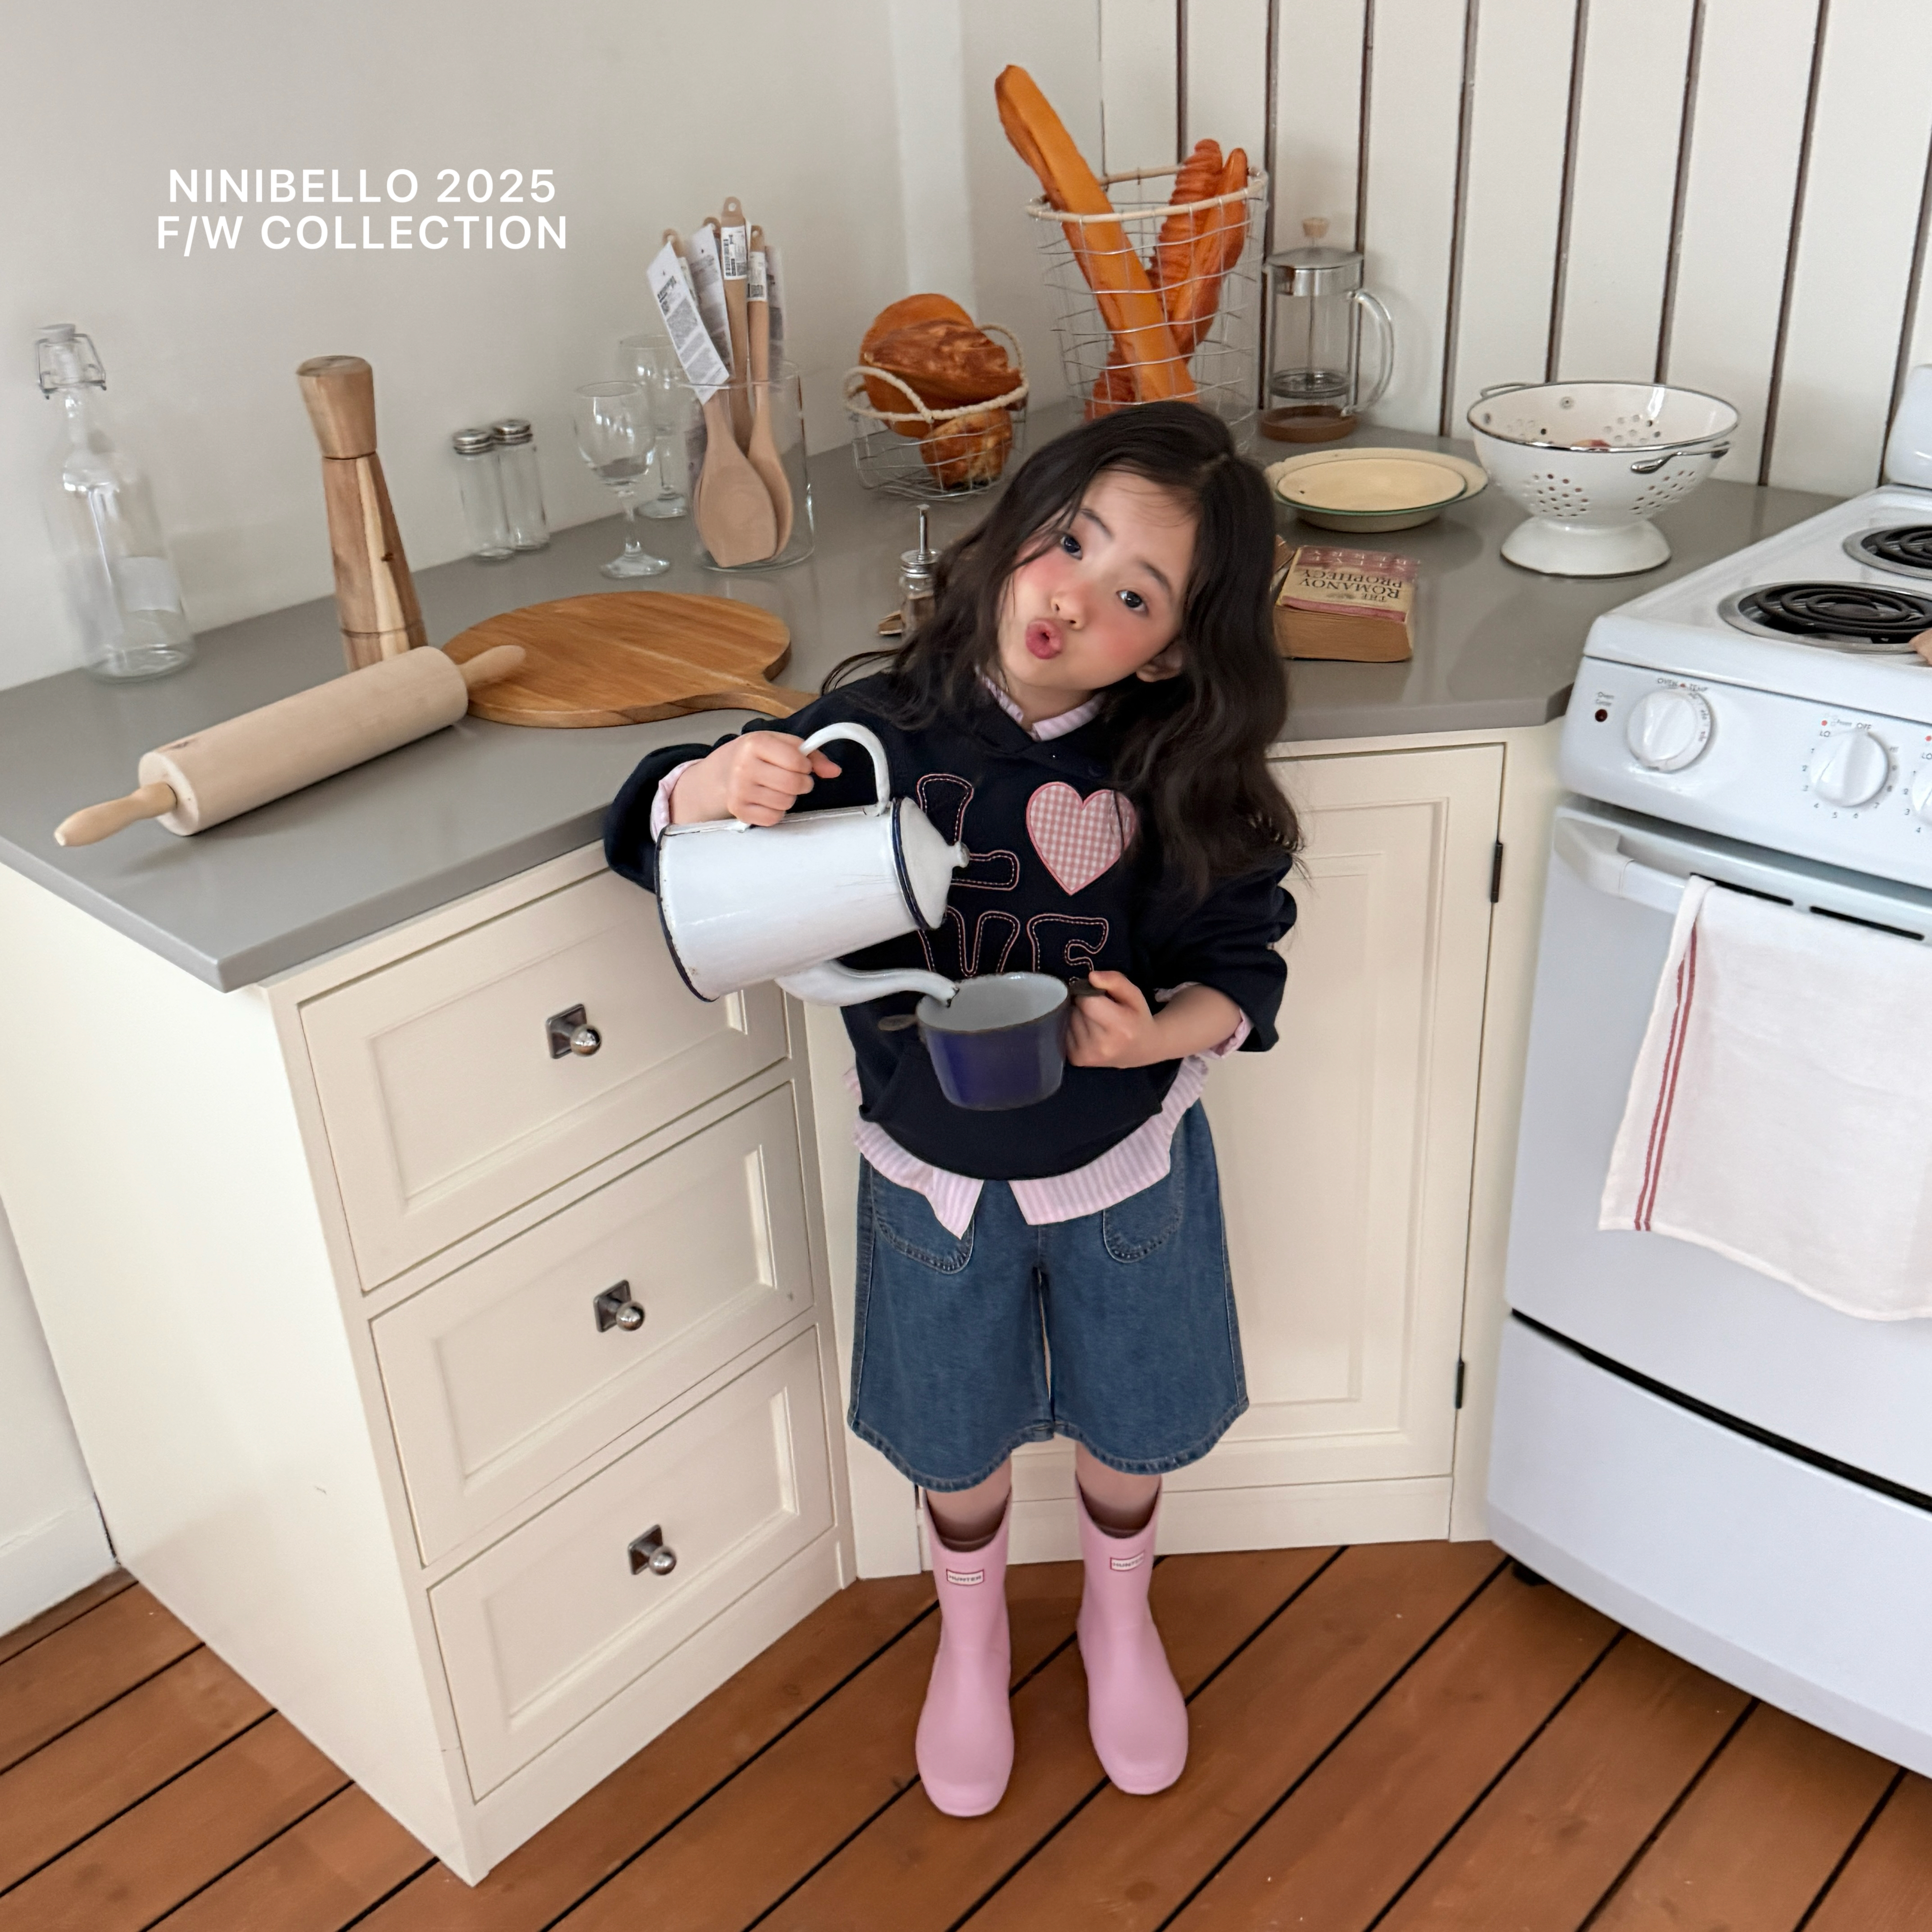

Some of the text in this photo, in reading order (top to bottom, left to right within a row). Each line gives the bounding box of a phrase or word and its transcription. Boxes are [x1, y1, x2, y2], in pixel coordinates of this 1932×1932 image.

[1299, 578, 1400, 600] ROMANOV
[1302, 569, 1402, 589] PROPHECY
[1361, 592, 1387, 603] THE
